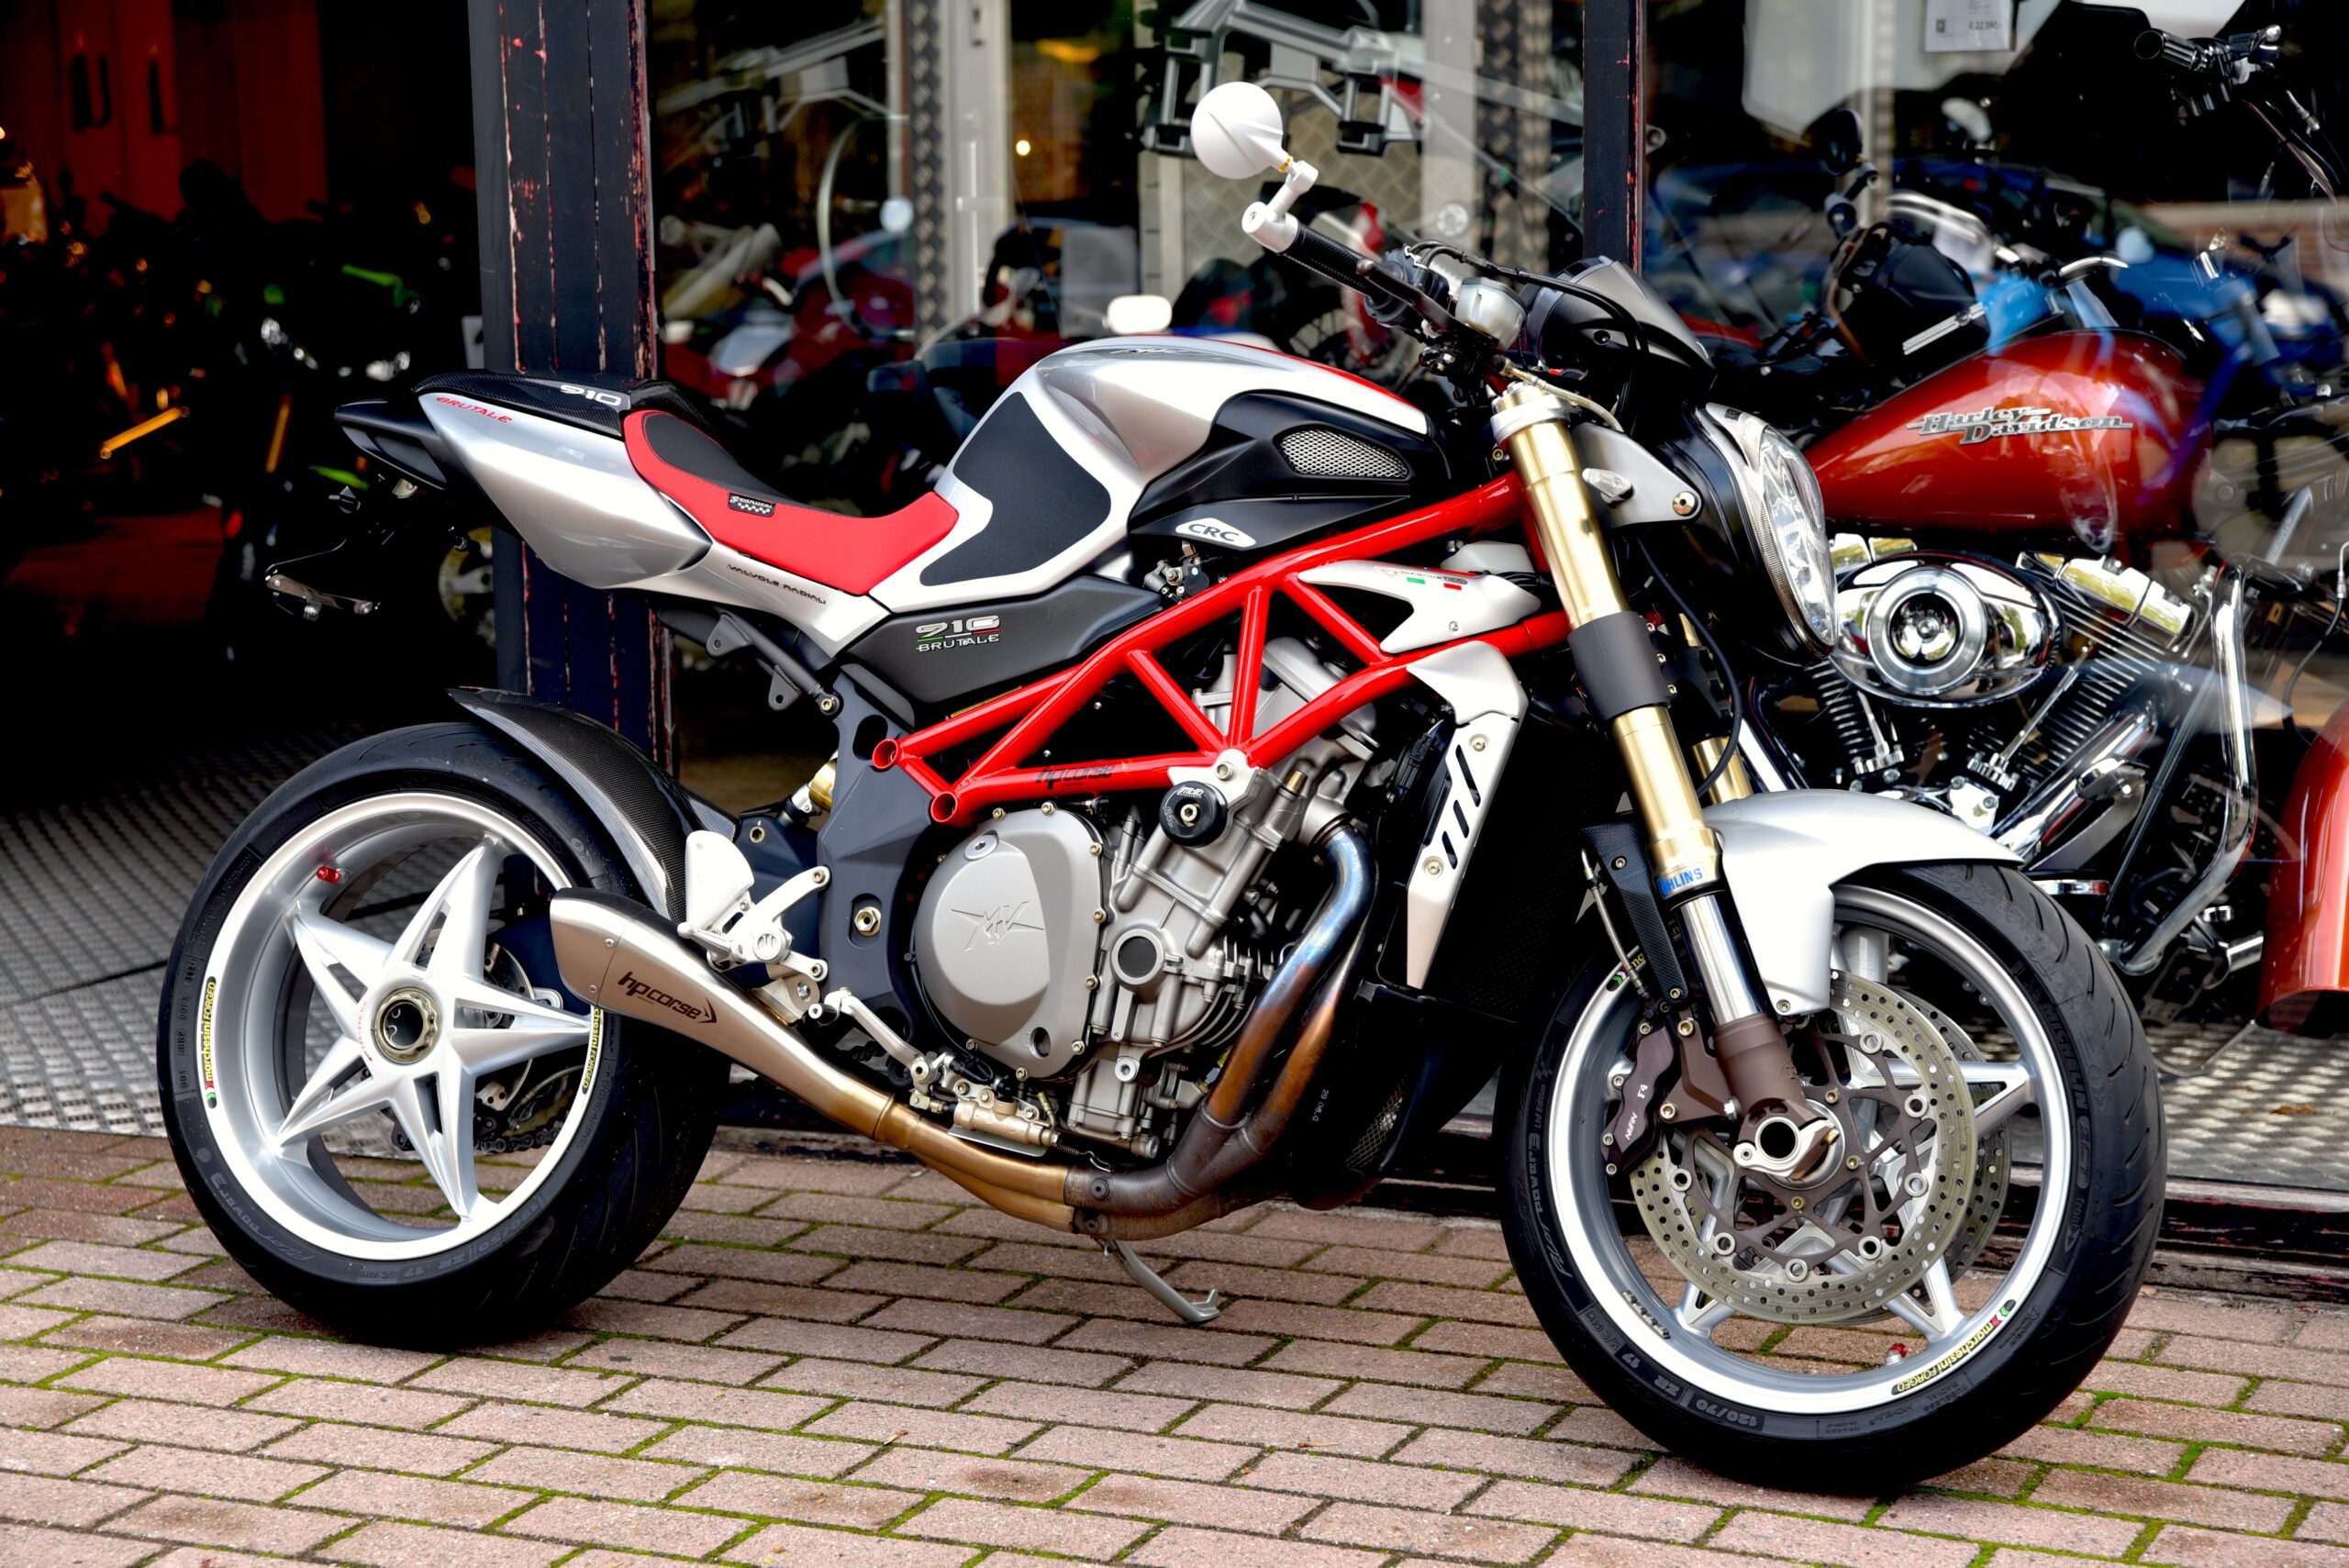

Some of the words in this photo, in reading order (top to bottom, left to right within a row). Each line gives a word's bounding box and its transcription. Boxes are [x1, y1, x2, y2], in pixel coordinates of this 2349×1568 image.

[560, 384, 622, 406] 910
[436, 396, 513, 424] BRUTALE
[1952, 413, 2133, 445] Davidson
[1187, 524, 1239, 541] CRC
[916, 615, 1000, 639] 910
[916, 634, 999, 652] BRUTALE
[203, 981, 217, 1021] FORGED
[591, 1007, 602, 1051] chesini
[582, 1048, 598, 1089] FORGED
[1620, 1348, 1642, 1369] 17
[1938, 1320, 1995, 1374] marchesini
[1651, 1373, 1681, 1397] ZR
[1896, 1366, 1938, 1393] FORGED
[1693, 1396, 1758, 1427] 120/70
